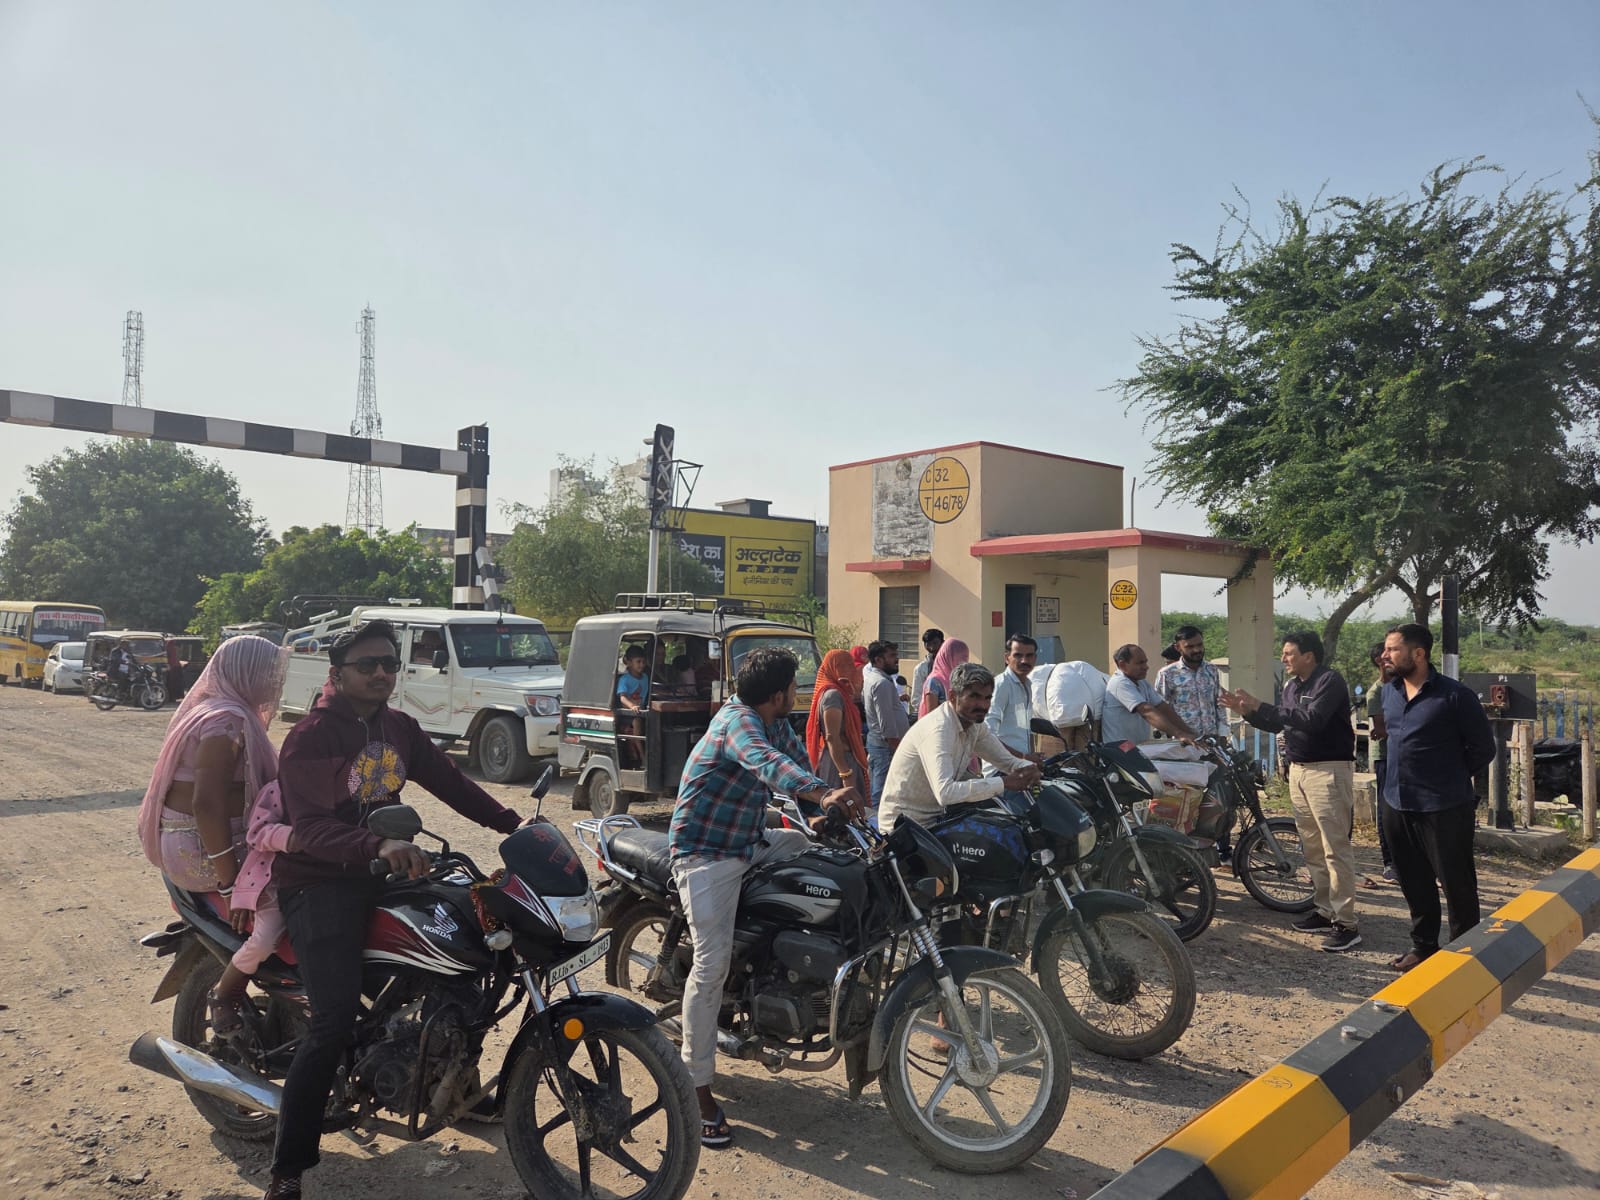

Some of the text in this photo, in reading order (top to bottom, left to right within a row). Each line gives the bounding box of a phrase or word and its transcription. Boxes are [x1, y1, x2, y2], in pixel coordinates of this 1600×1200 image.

[925, 468, 949, 484] C 32
[924, 496, 932, 511] T
[703, 546, 722, 560] का
[735, 545, 803, 565] अल्ट्राटेक
[961, 845, 986, 857] Hero
[805, 884, 831, 898] Hero
[422, 924, 453, 941] HONDA
